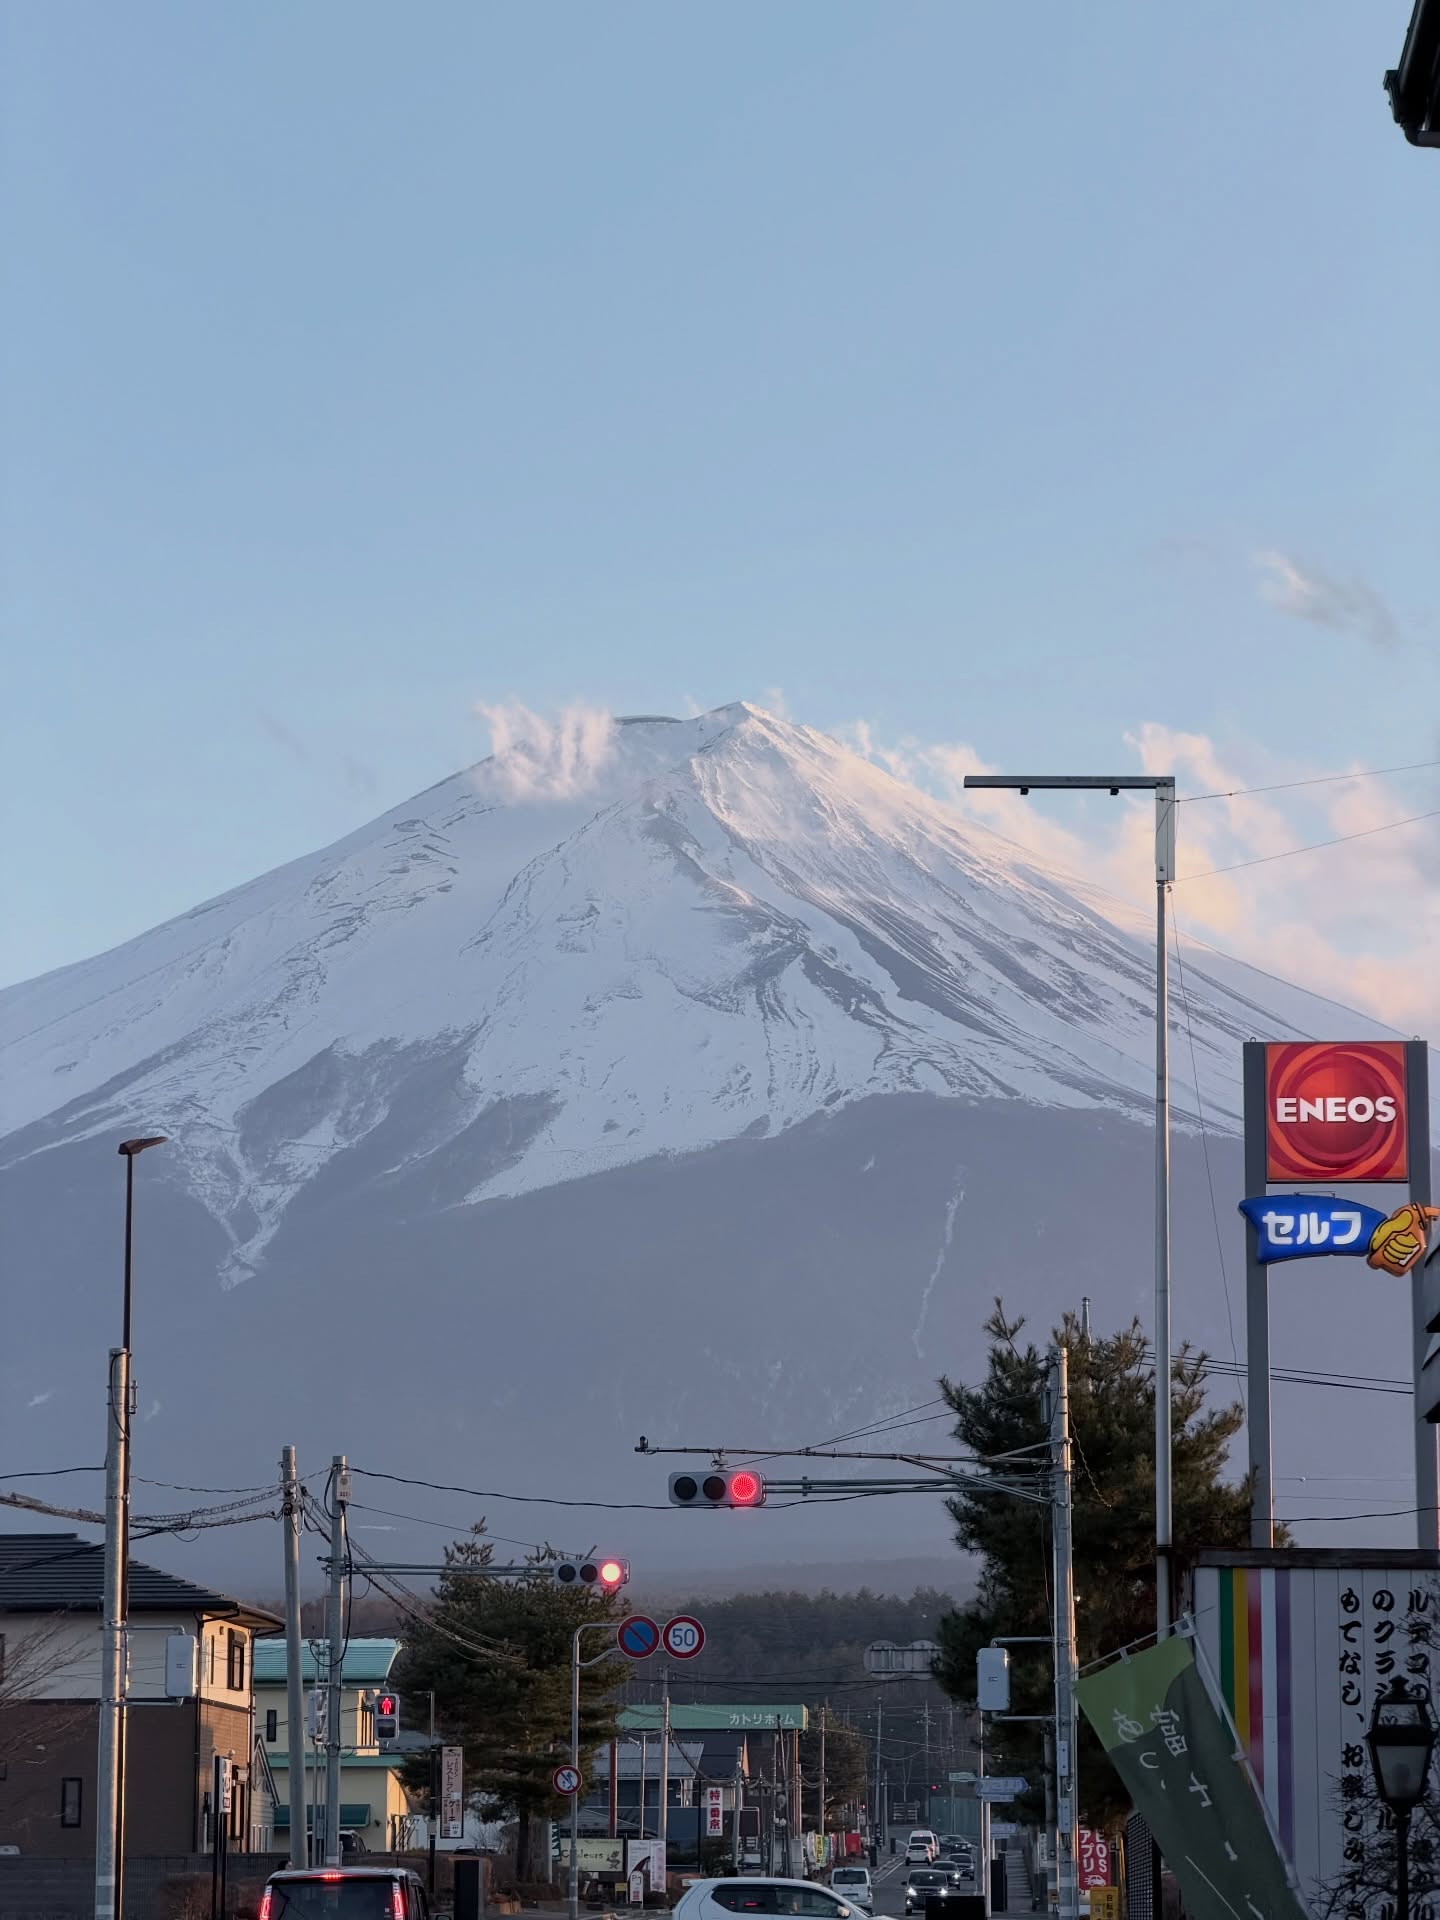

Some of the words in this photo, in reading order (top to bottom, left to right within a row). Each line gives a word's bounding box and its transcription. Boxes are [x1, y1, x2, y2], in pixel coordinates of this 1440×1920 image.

[1276, 1096, 1397, 1123] ENEOS
[1262, 1211, 1362, 1245] セルフ
[672, 1628, 695, 1647] 50
[561, 1848, 604, 1859] Culeurs
[1080, 1829, 1095, 1873] アプリ
